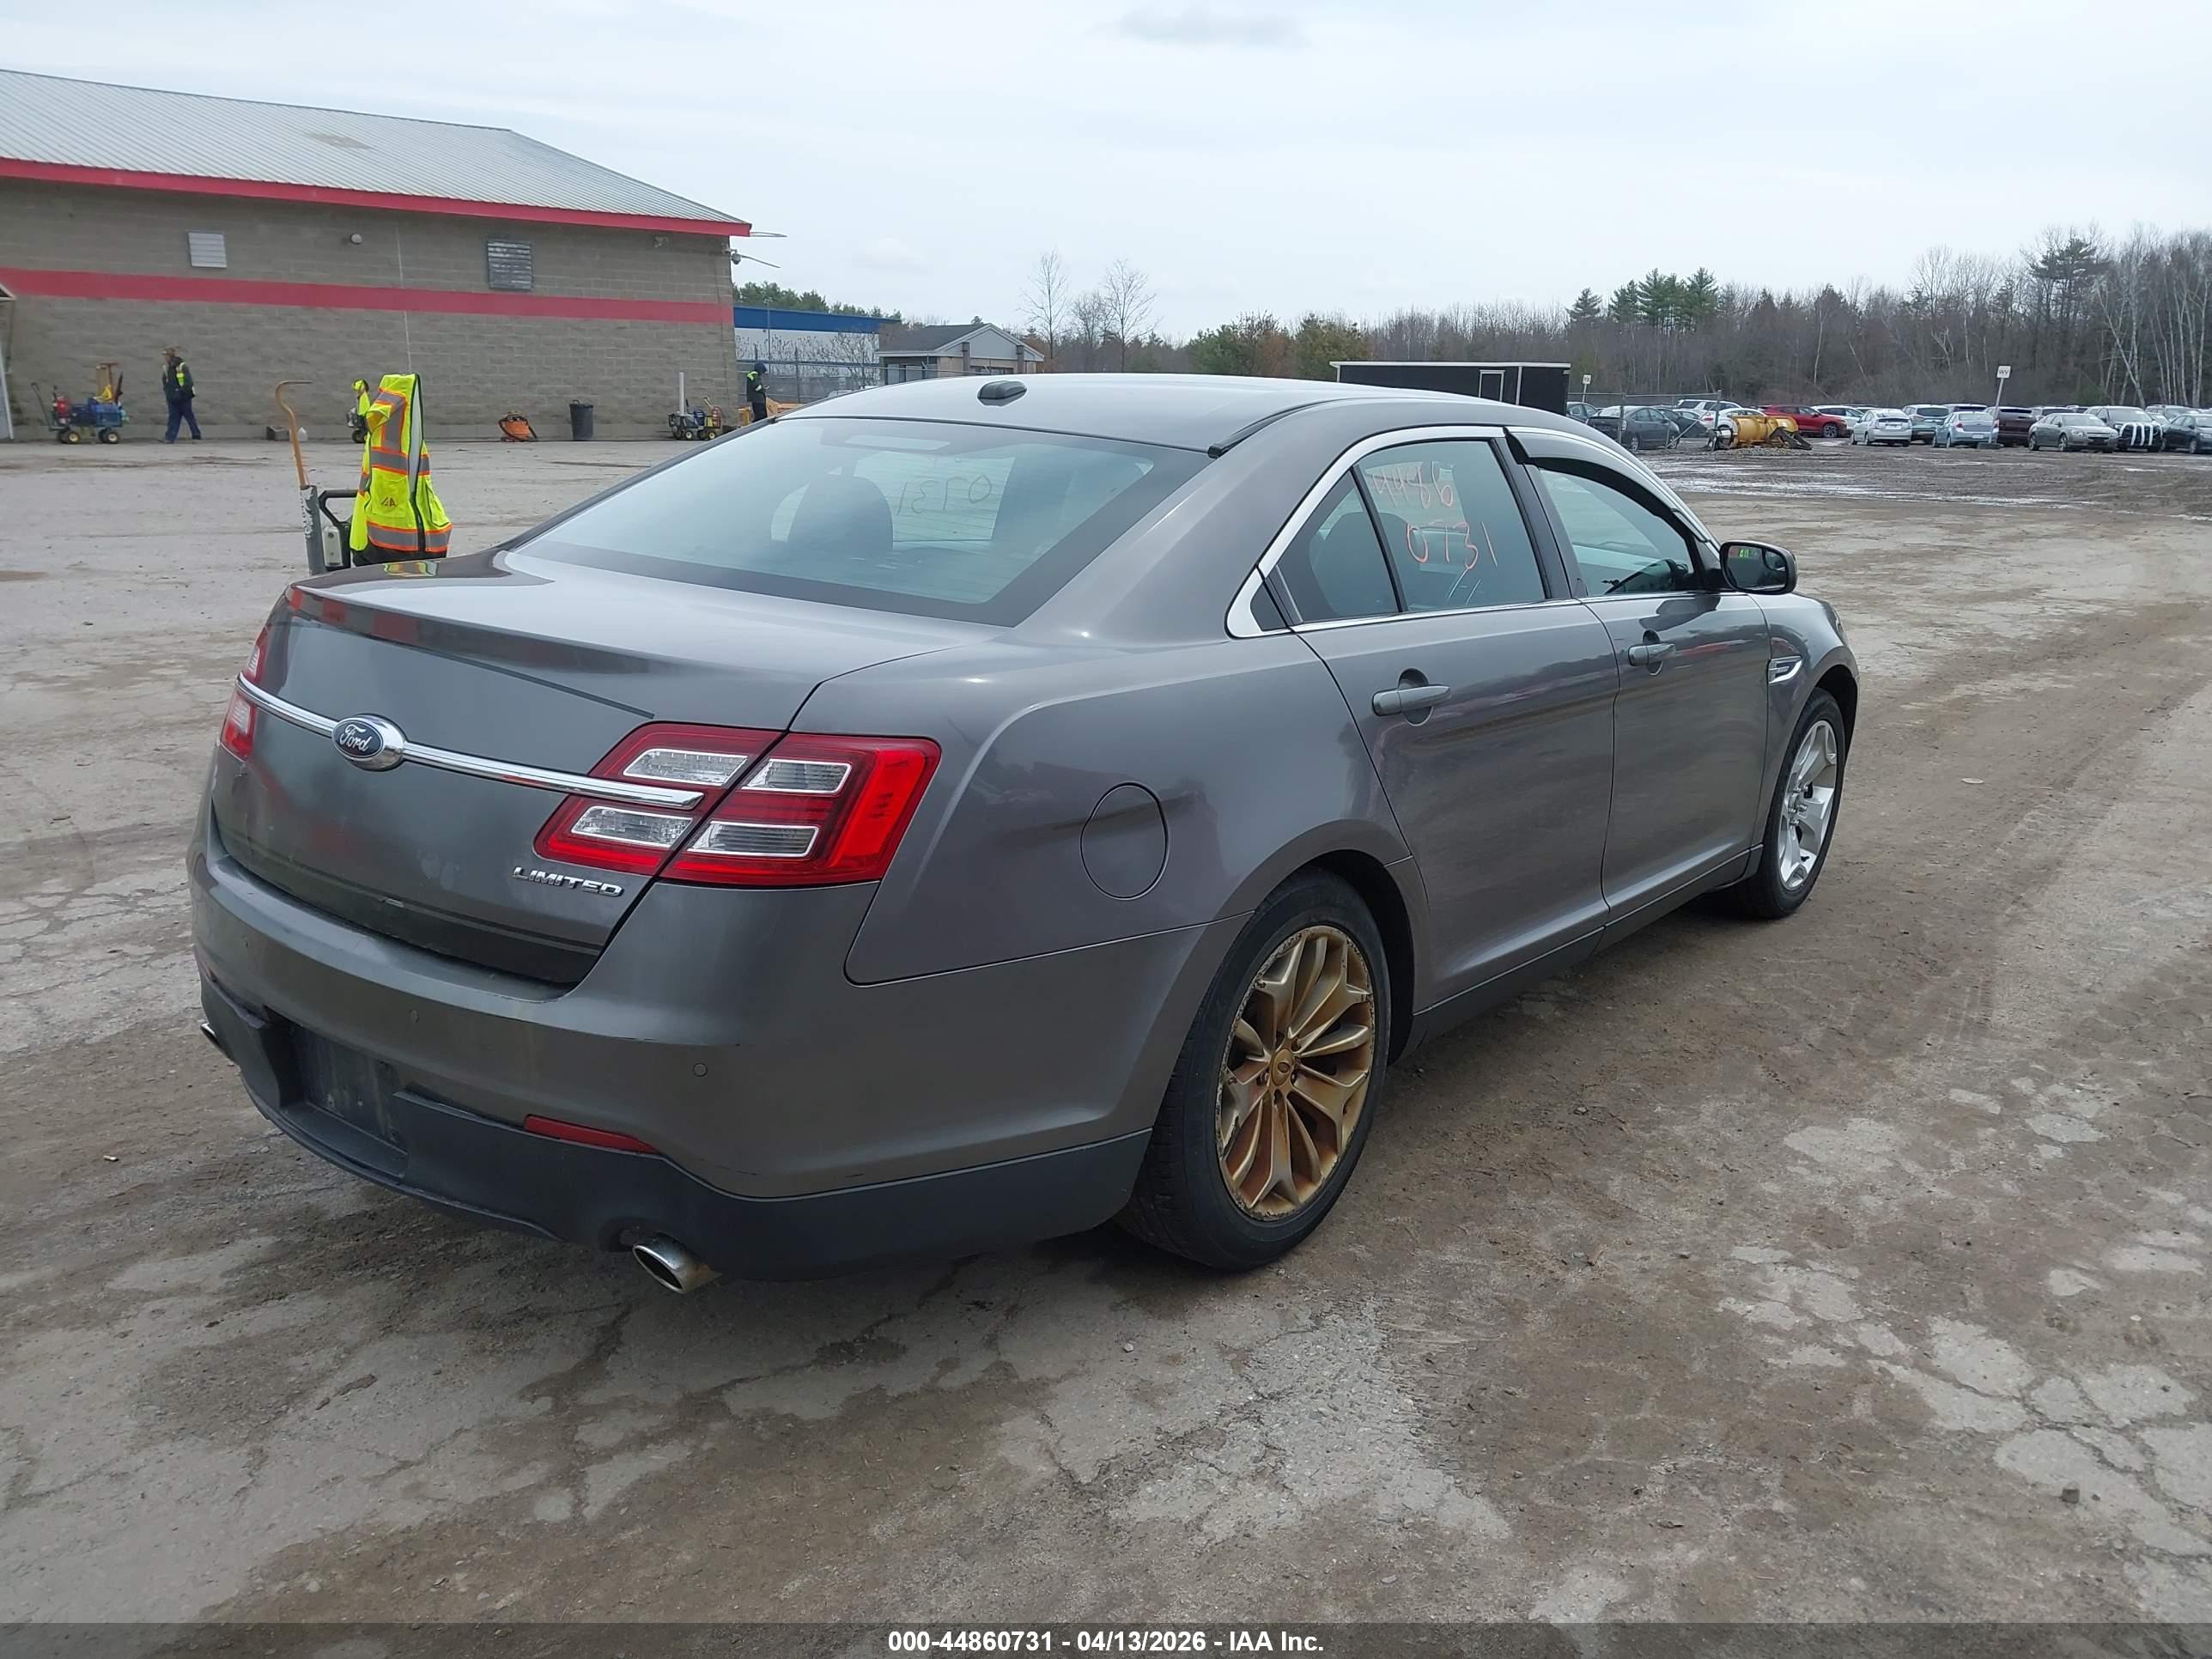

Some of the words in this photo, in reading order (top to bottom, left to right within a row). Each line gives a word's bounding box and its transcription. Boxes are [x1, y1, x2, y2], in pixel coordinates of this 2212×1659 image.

[1406, 519, 1498, 570] 0731
[340, 724, 373, 752] Ford
[513, 866, 624, 897] LIMITED
